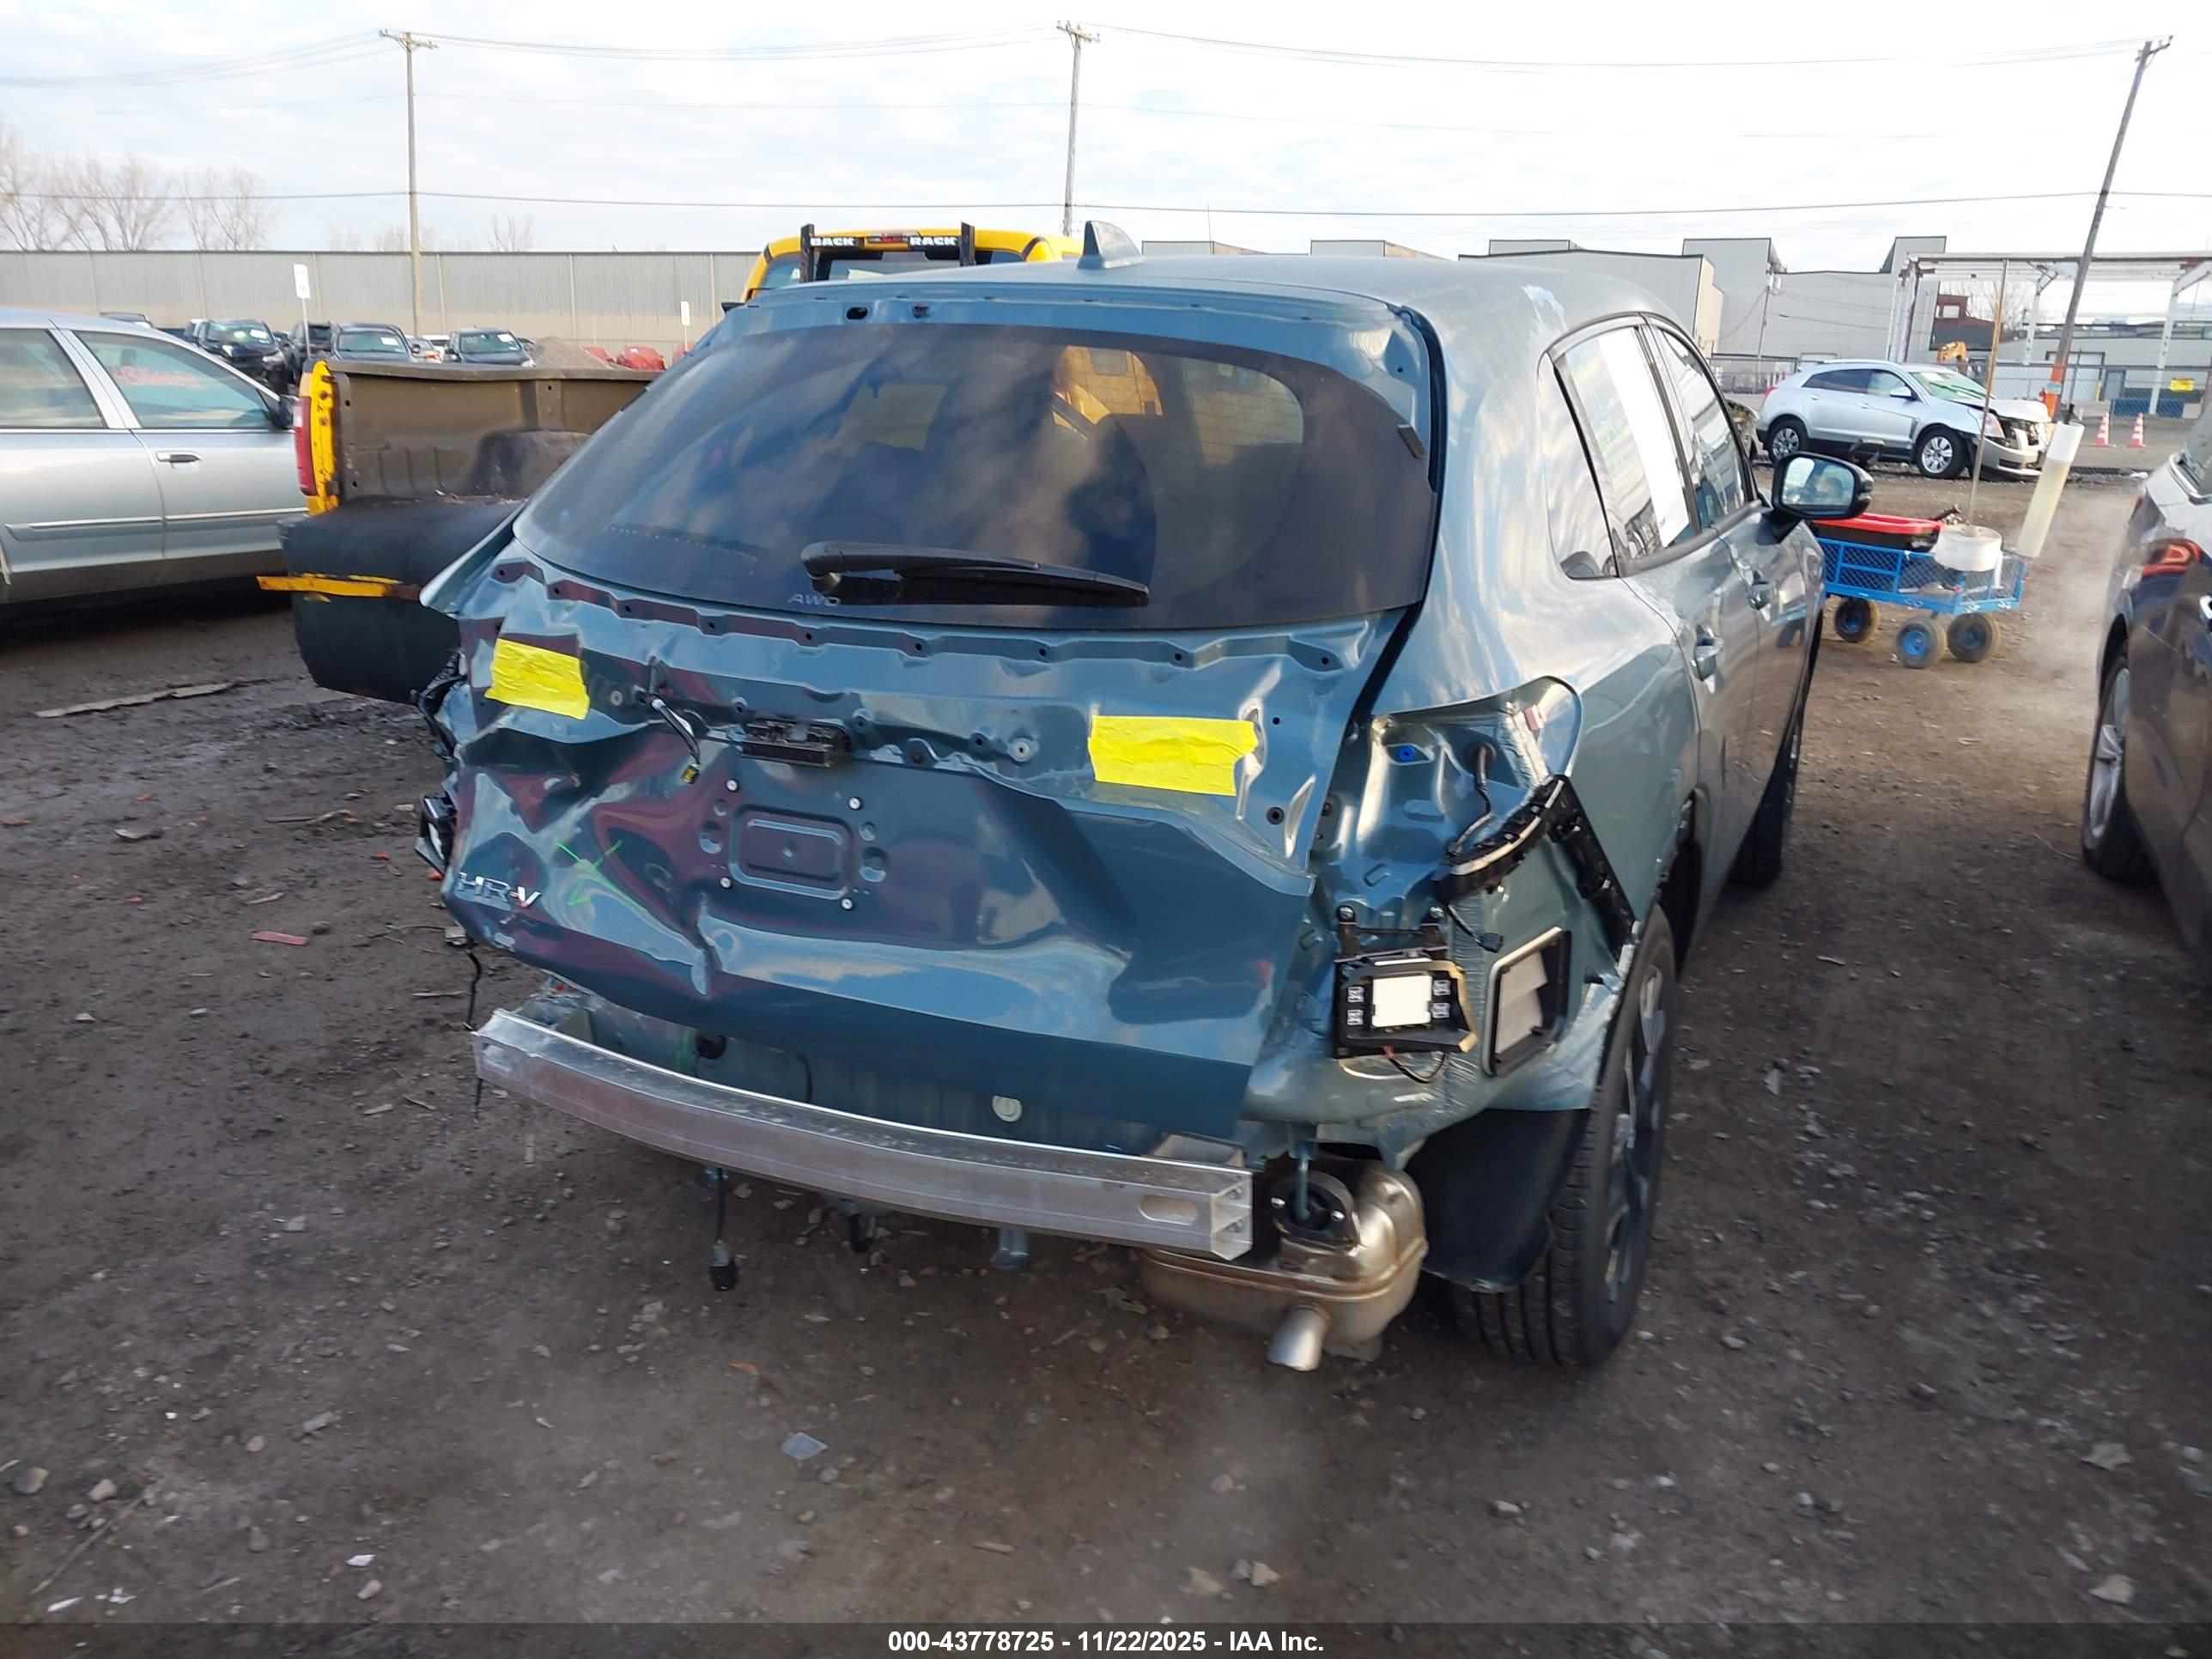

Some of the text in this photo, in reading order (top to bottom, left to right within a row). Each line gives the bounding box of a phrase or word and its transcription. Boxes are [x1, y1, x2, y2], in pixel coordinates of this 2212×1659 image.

[810, 237, 957, 246] BACK RACK
[788, 594, 841, 607] AWD
[457, 872, 542, 907] HR-V
